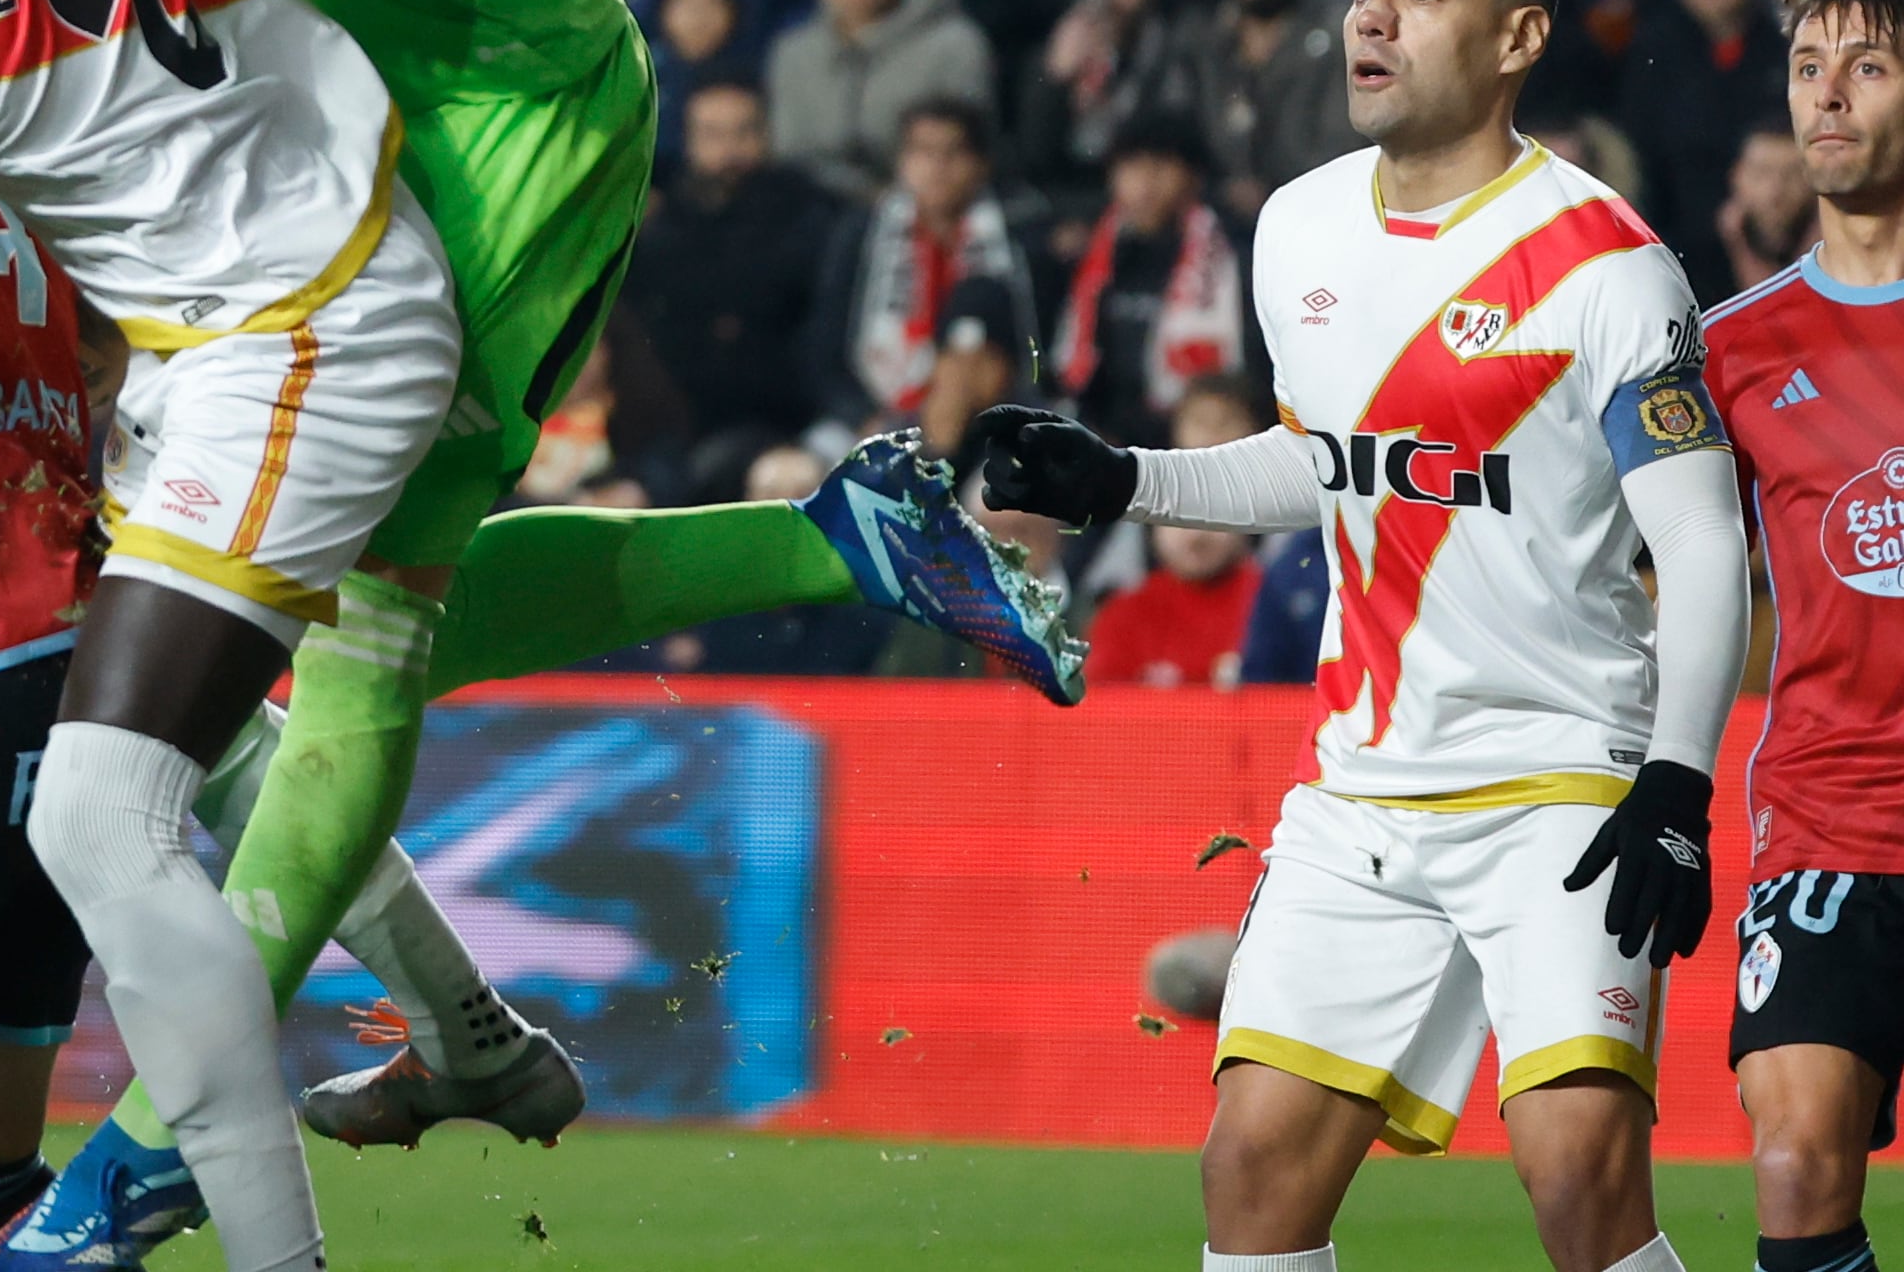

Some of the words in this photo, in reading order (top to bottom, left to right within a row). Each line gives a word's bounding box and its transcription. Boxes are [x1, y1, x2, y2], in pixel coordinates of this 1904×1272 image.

[1300, 314, 1330, 326] umbro
[1307, 429, 1512, 515] DIGI
[161, 502, 208, 524] umbro
[1664, 827, 1701, 854] umbro
